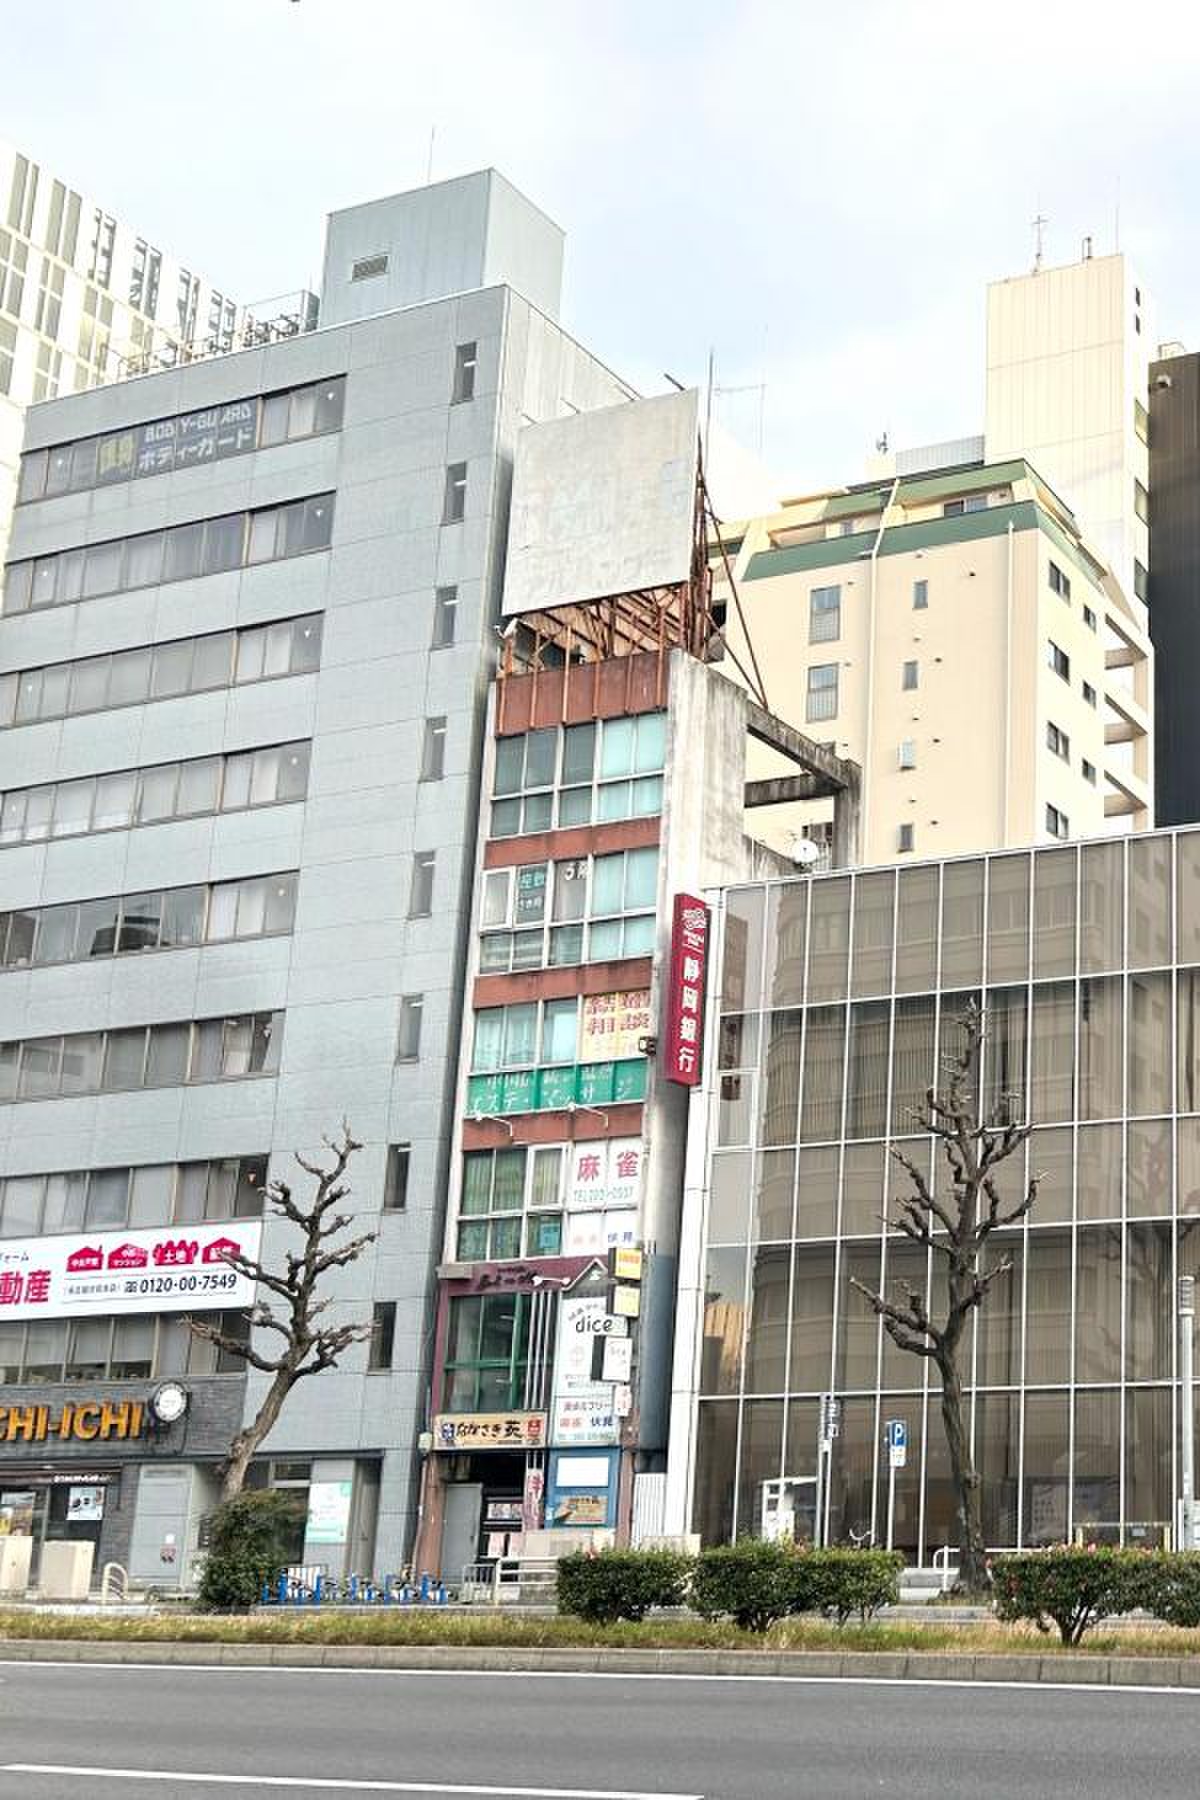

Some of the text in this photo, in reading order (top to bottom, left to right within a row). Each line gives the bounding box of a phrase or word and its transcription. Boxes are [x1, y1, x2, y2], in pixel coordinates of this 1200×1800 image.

[139, 427, 254, 470] ボディーガード
[577, 1151, 638, 1182] 麻雀
[165, 1250, 187, 1263] 土地
[0, 1269, 51, 1305] 動産
[576, 1316, 613, 1333] dice
[895, 1423, 904, 1445] P
